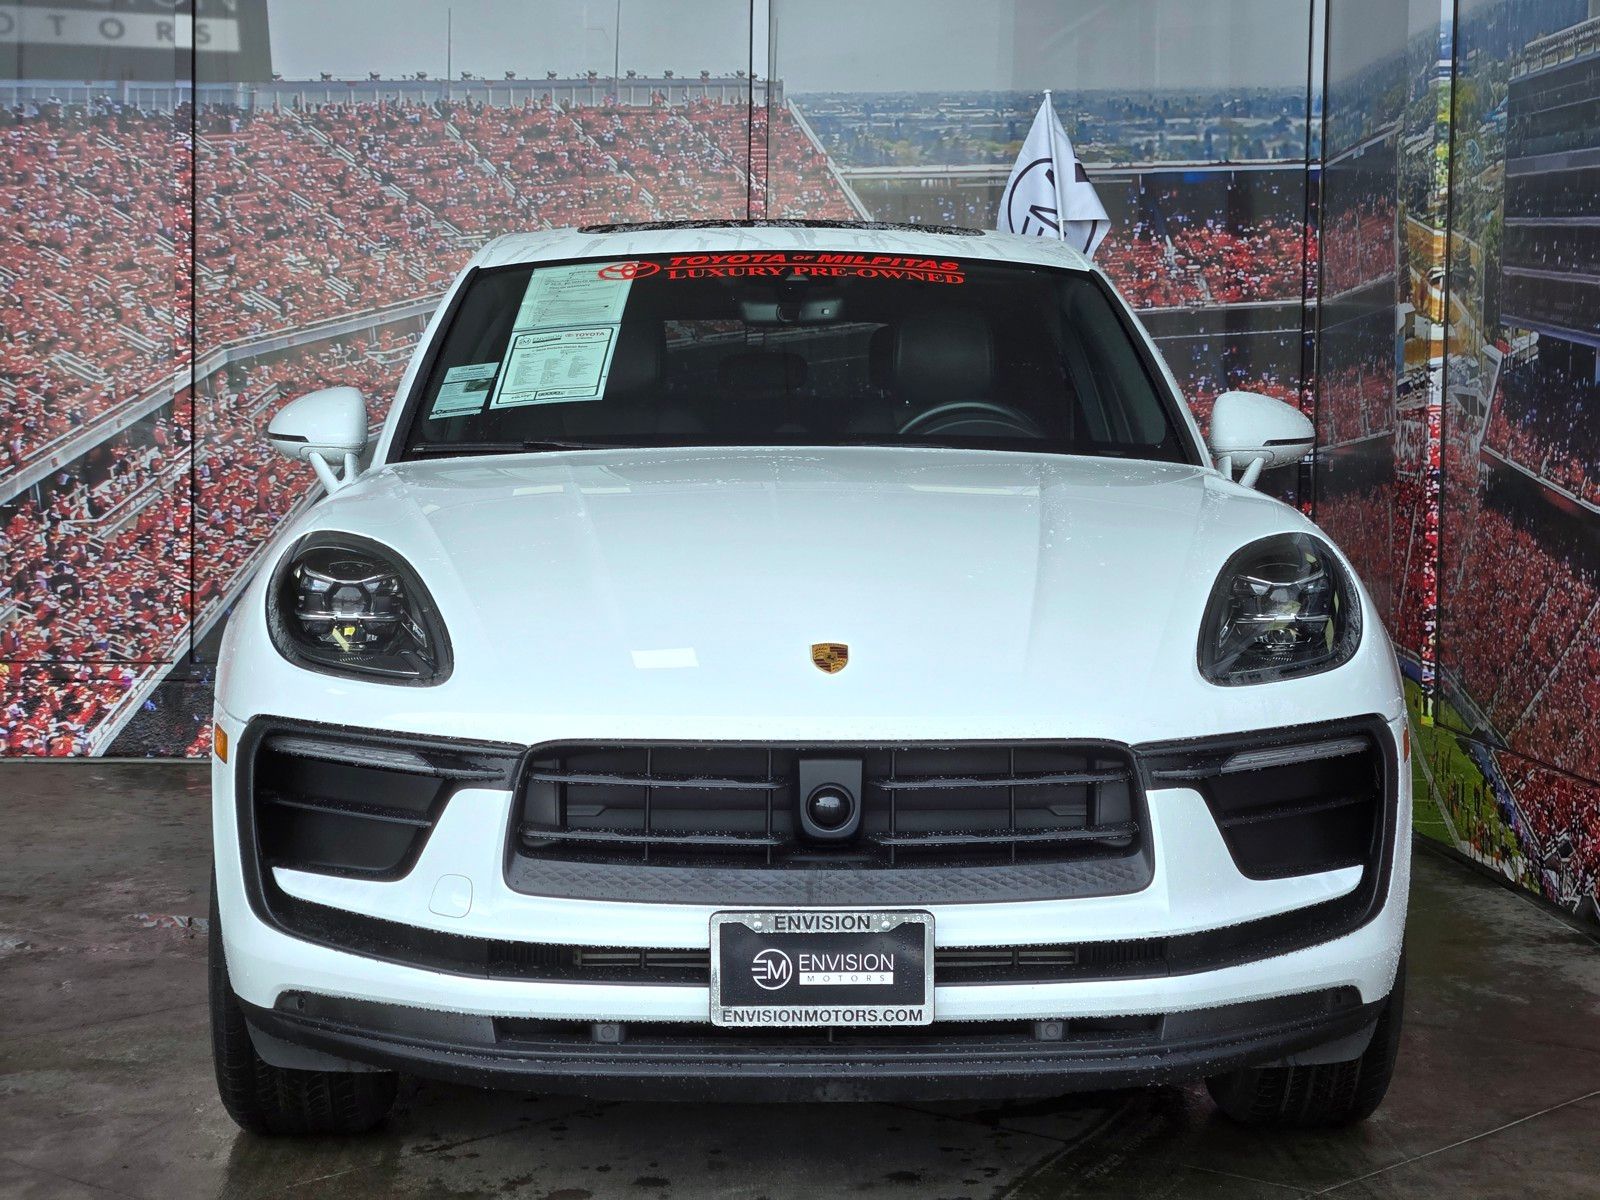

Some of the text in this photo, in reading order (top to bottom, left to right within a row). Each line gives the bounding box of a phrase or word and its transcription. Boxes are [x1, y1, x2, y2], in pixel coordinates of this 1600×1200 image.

[0, 13, 212, 45] OTORS
[670, 254, 786, 266] TOYOTA
[817, 254, 961, 271] MILPITAS
[667, 266, 965, 284] LUXURY PRE-OWNED
[774, 915, 871, 930] ENVISION
[798, 953, 894, 972] ENVISION
[806, 974, 886, 983] MOTORS
[722, 1008, 924, 1024] ENVISIONMOTORS.COM
